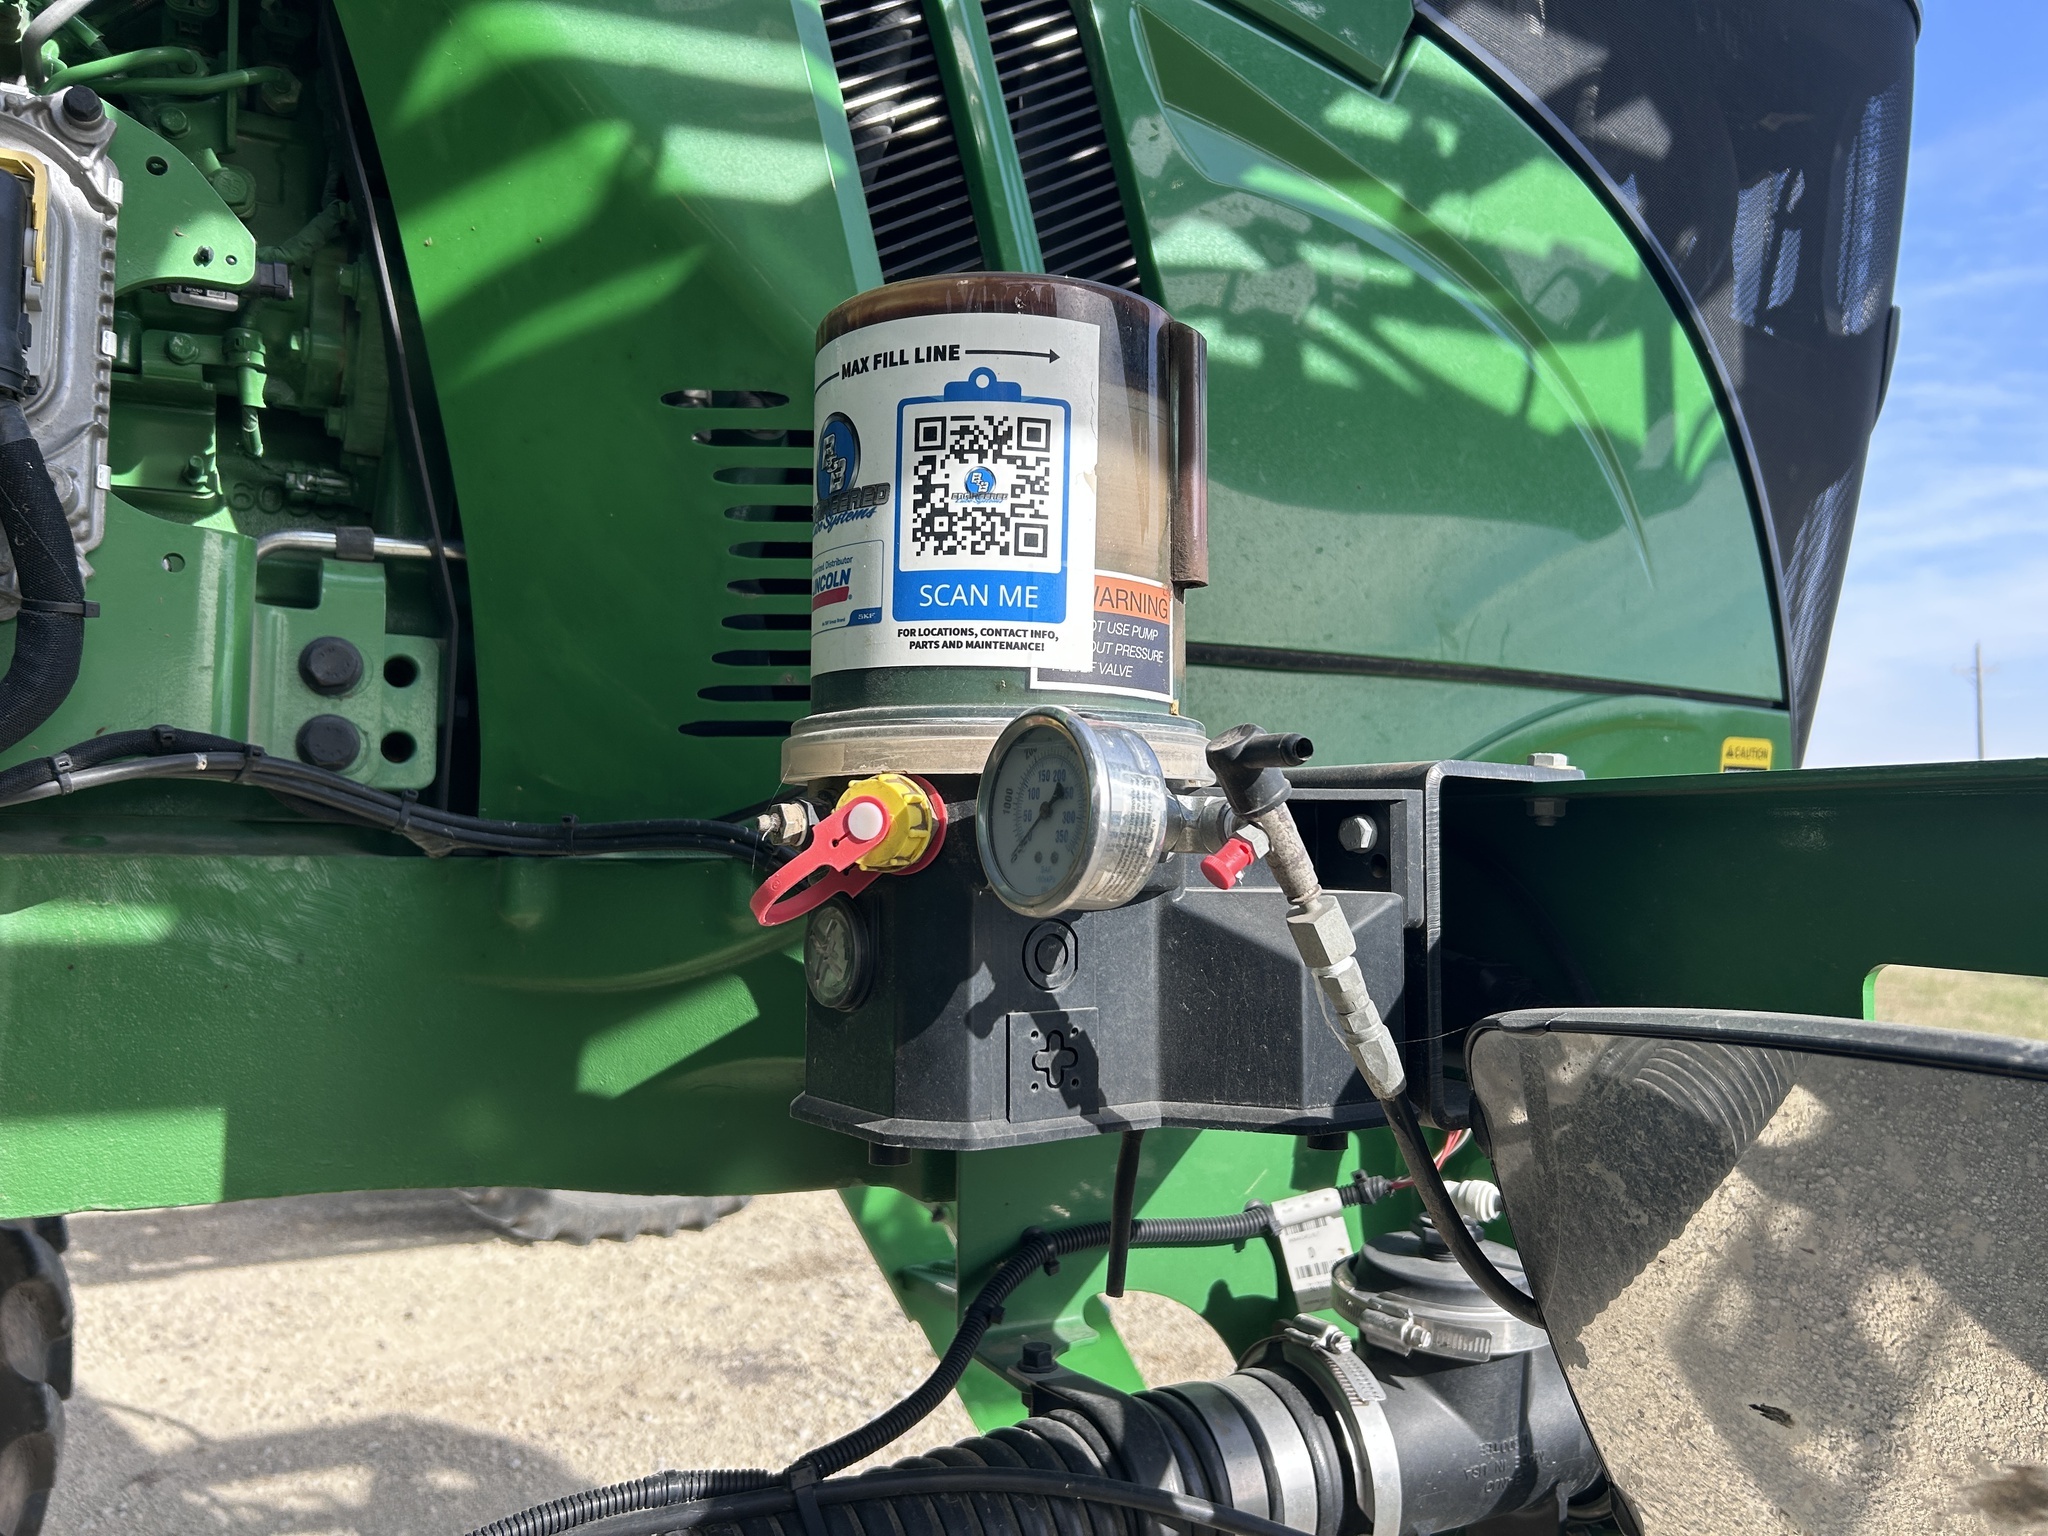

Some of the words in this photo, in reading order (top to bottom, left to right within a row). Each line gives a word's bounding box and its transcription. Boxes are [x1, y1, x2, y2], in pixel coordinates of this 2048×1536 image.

[841, 356, 871, 380] MAX
[872, 348, 910, 371] FILL
[914, 344, 961, 364] LINE
[823, 506, 877, 533] Systems
[919, 583, 989, 608] SCAN
[999, 584, 1039, 609] ME
[857, 612, 876, 621] SKF
[897, 628, 917, 638] FOR
[918, 627, 979, 639] LOCATIONS,
[980, 627, 1029, 639] CONTACT
[1030, 629, 1060, 642] INFO,
[1093, 619, 1106, 633] OT
[1106, 621, 1131, 637] USE
[1131, 624, 1159, 641] PUMP
[909, 640, 940, 650] PARTS
[941, 640, 964, 650] AND
[965, 640, 1045, 652] MAINTENANCE!
[1114, 644, 1165, 664] PRESSURE
[1098, 661, 1134, 678] VALVE
[1735, 746, 1768, 760] CAUTION
[1038, 769, 1051, 783] 150
[1052, 768, 1067, 783] 200
[1027, 787, 1041, 800] 100
[1061, 786, 1074, 800] 50
[1003, 787, 1014, 815] 1000
[1023, 809, 1033, 822] 50
[1062, 810, 1076, 824] 300
[1055, 829, 1069, 843] 350
[1494, 1459, 1508, 1474] IN
